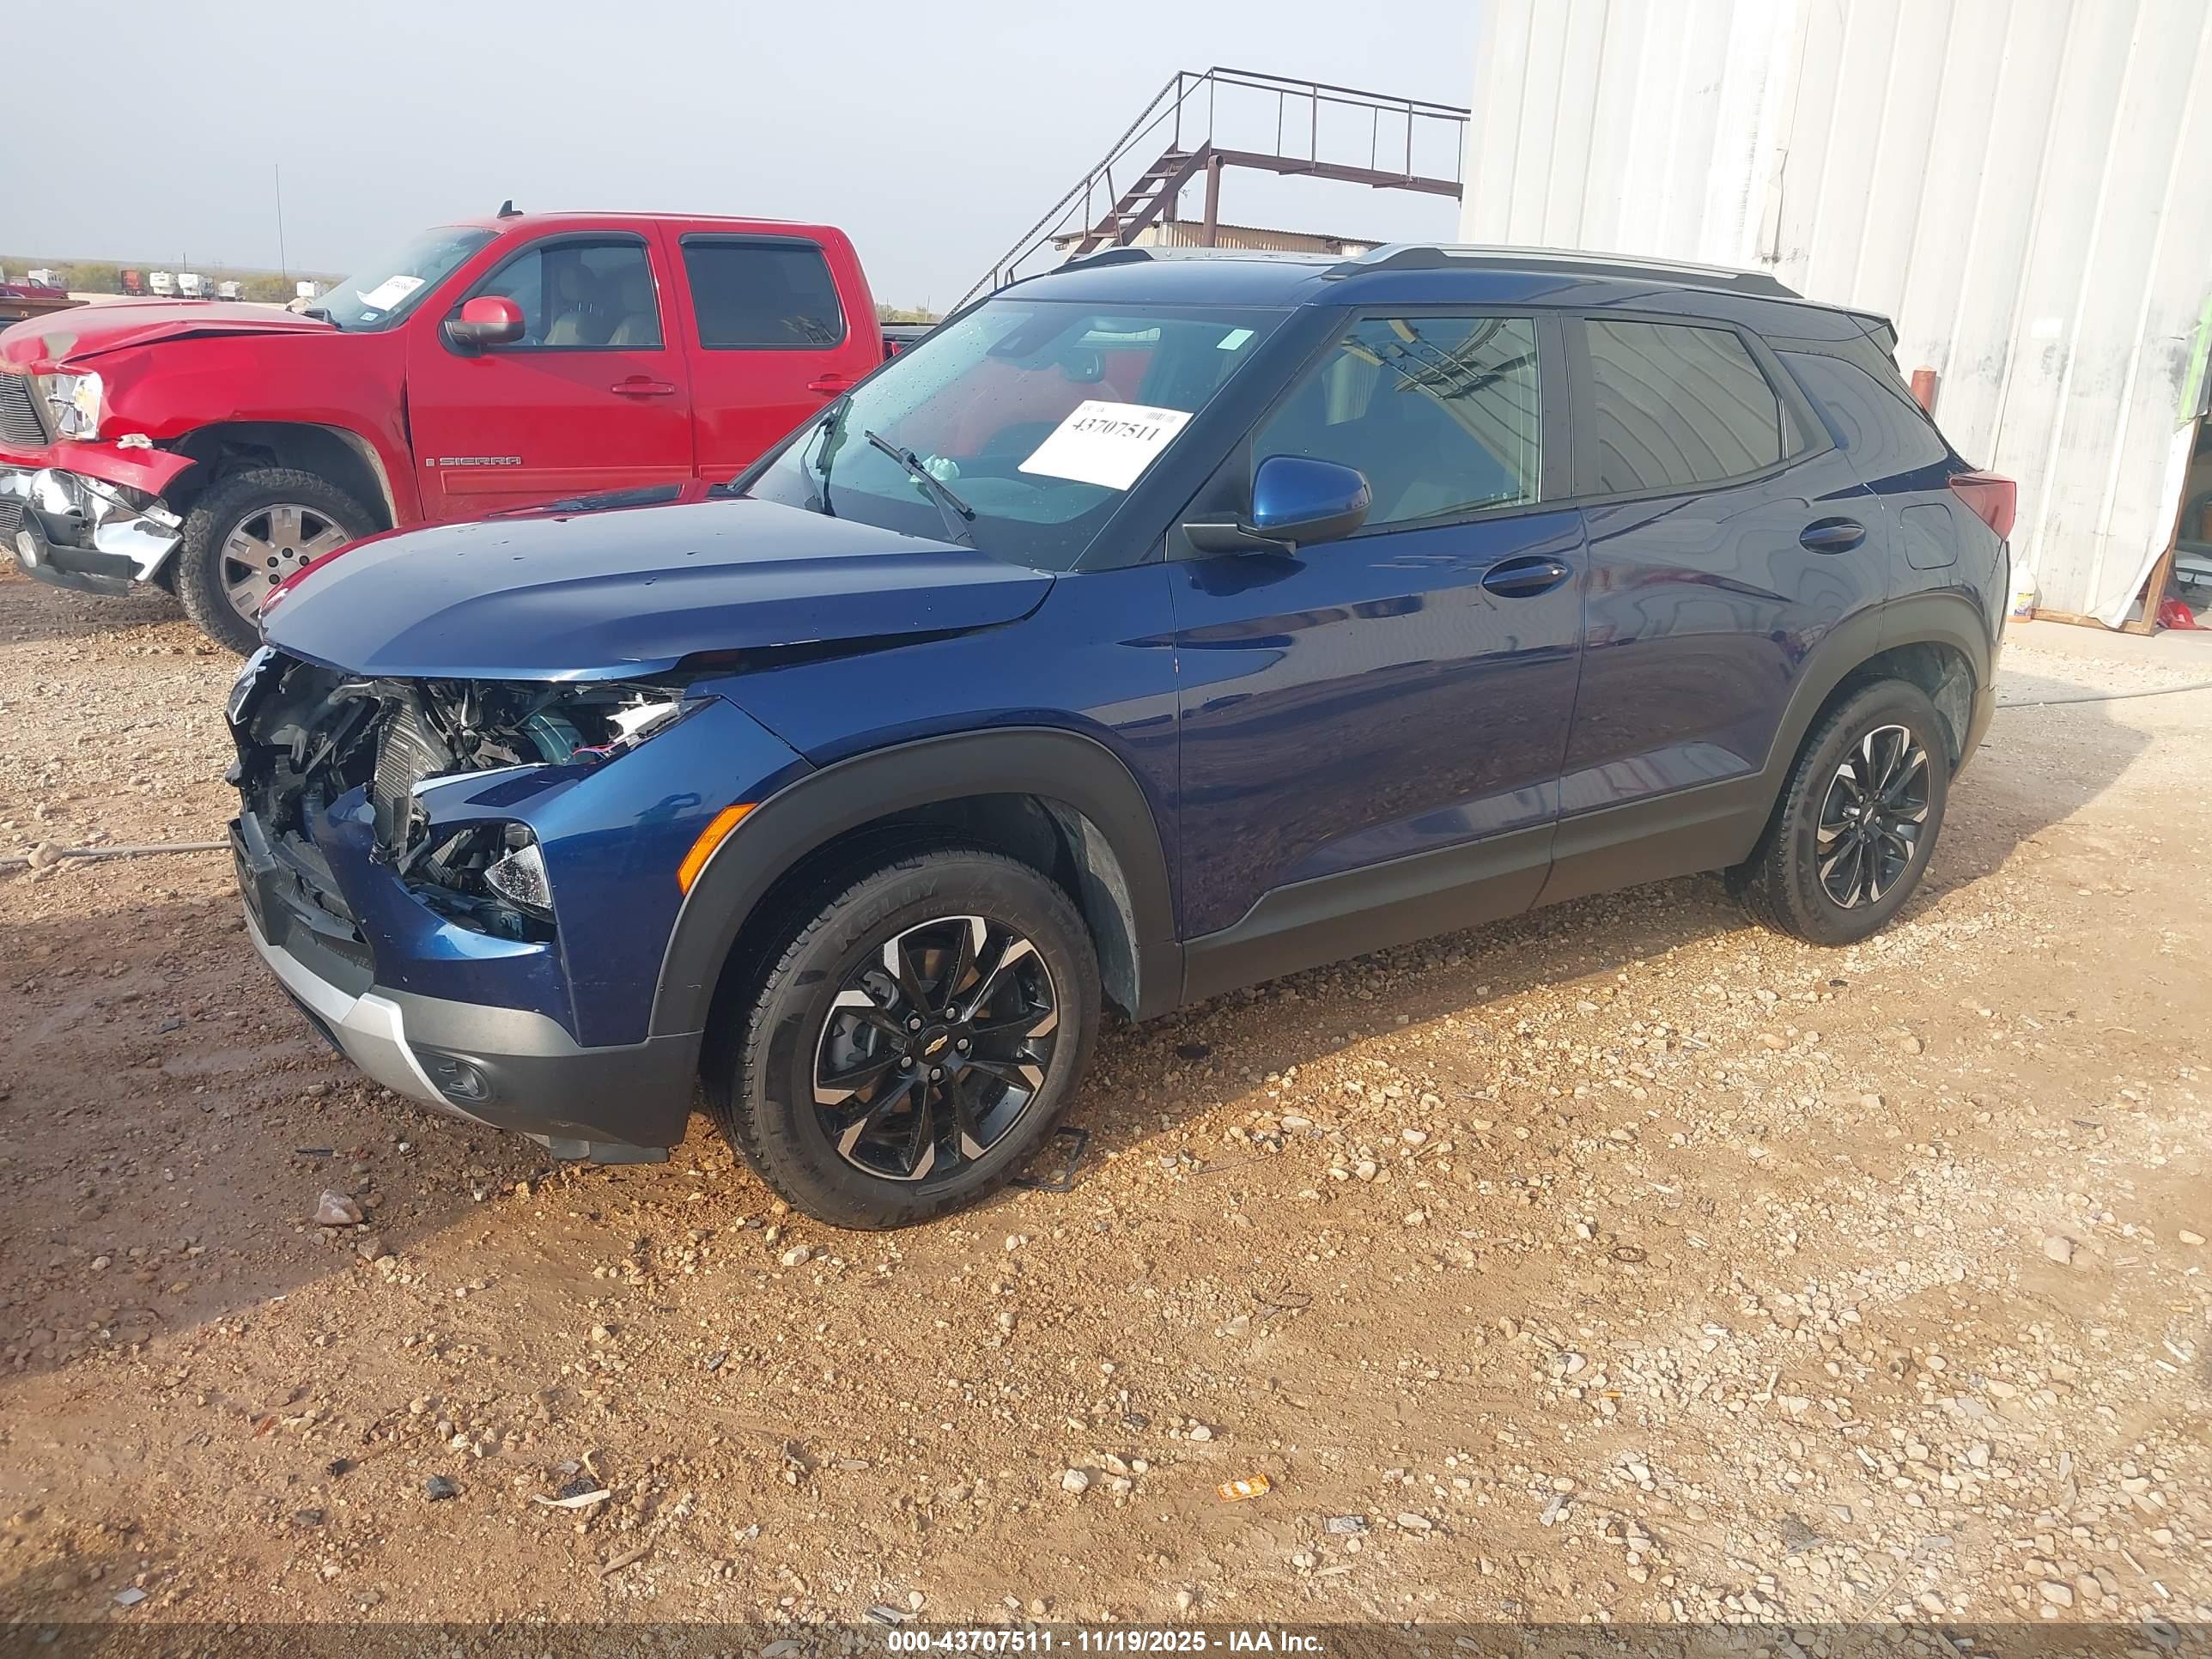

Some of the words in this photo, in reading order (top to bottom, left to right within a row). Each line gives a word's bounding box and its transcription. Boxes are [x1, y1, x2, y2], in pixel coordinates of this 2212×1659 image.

[1073, 417, 1161, 441] 43707511
[439, 457, 522, 465] SIERRA
[841, 876, 939, 955] KELLY
